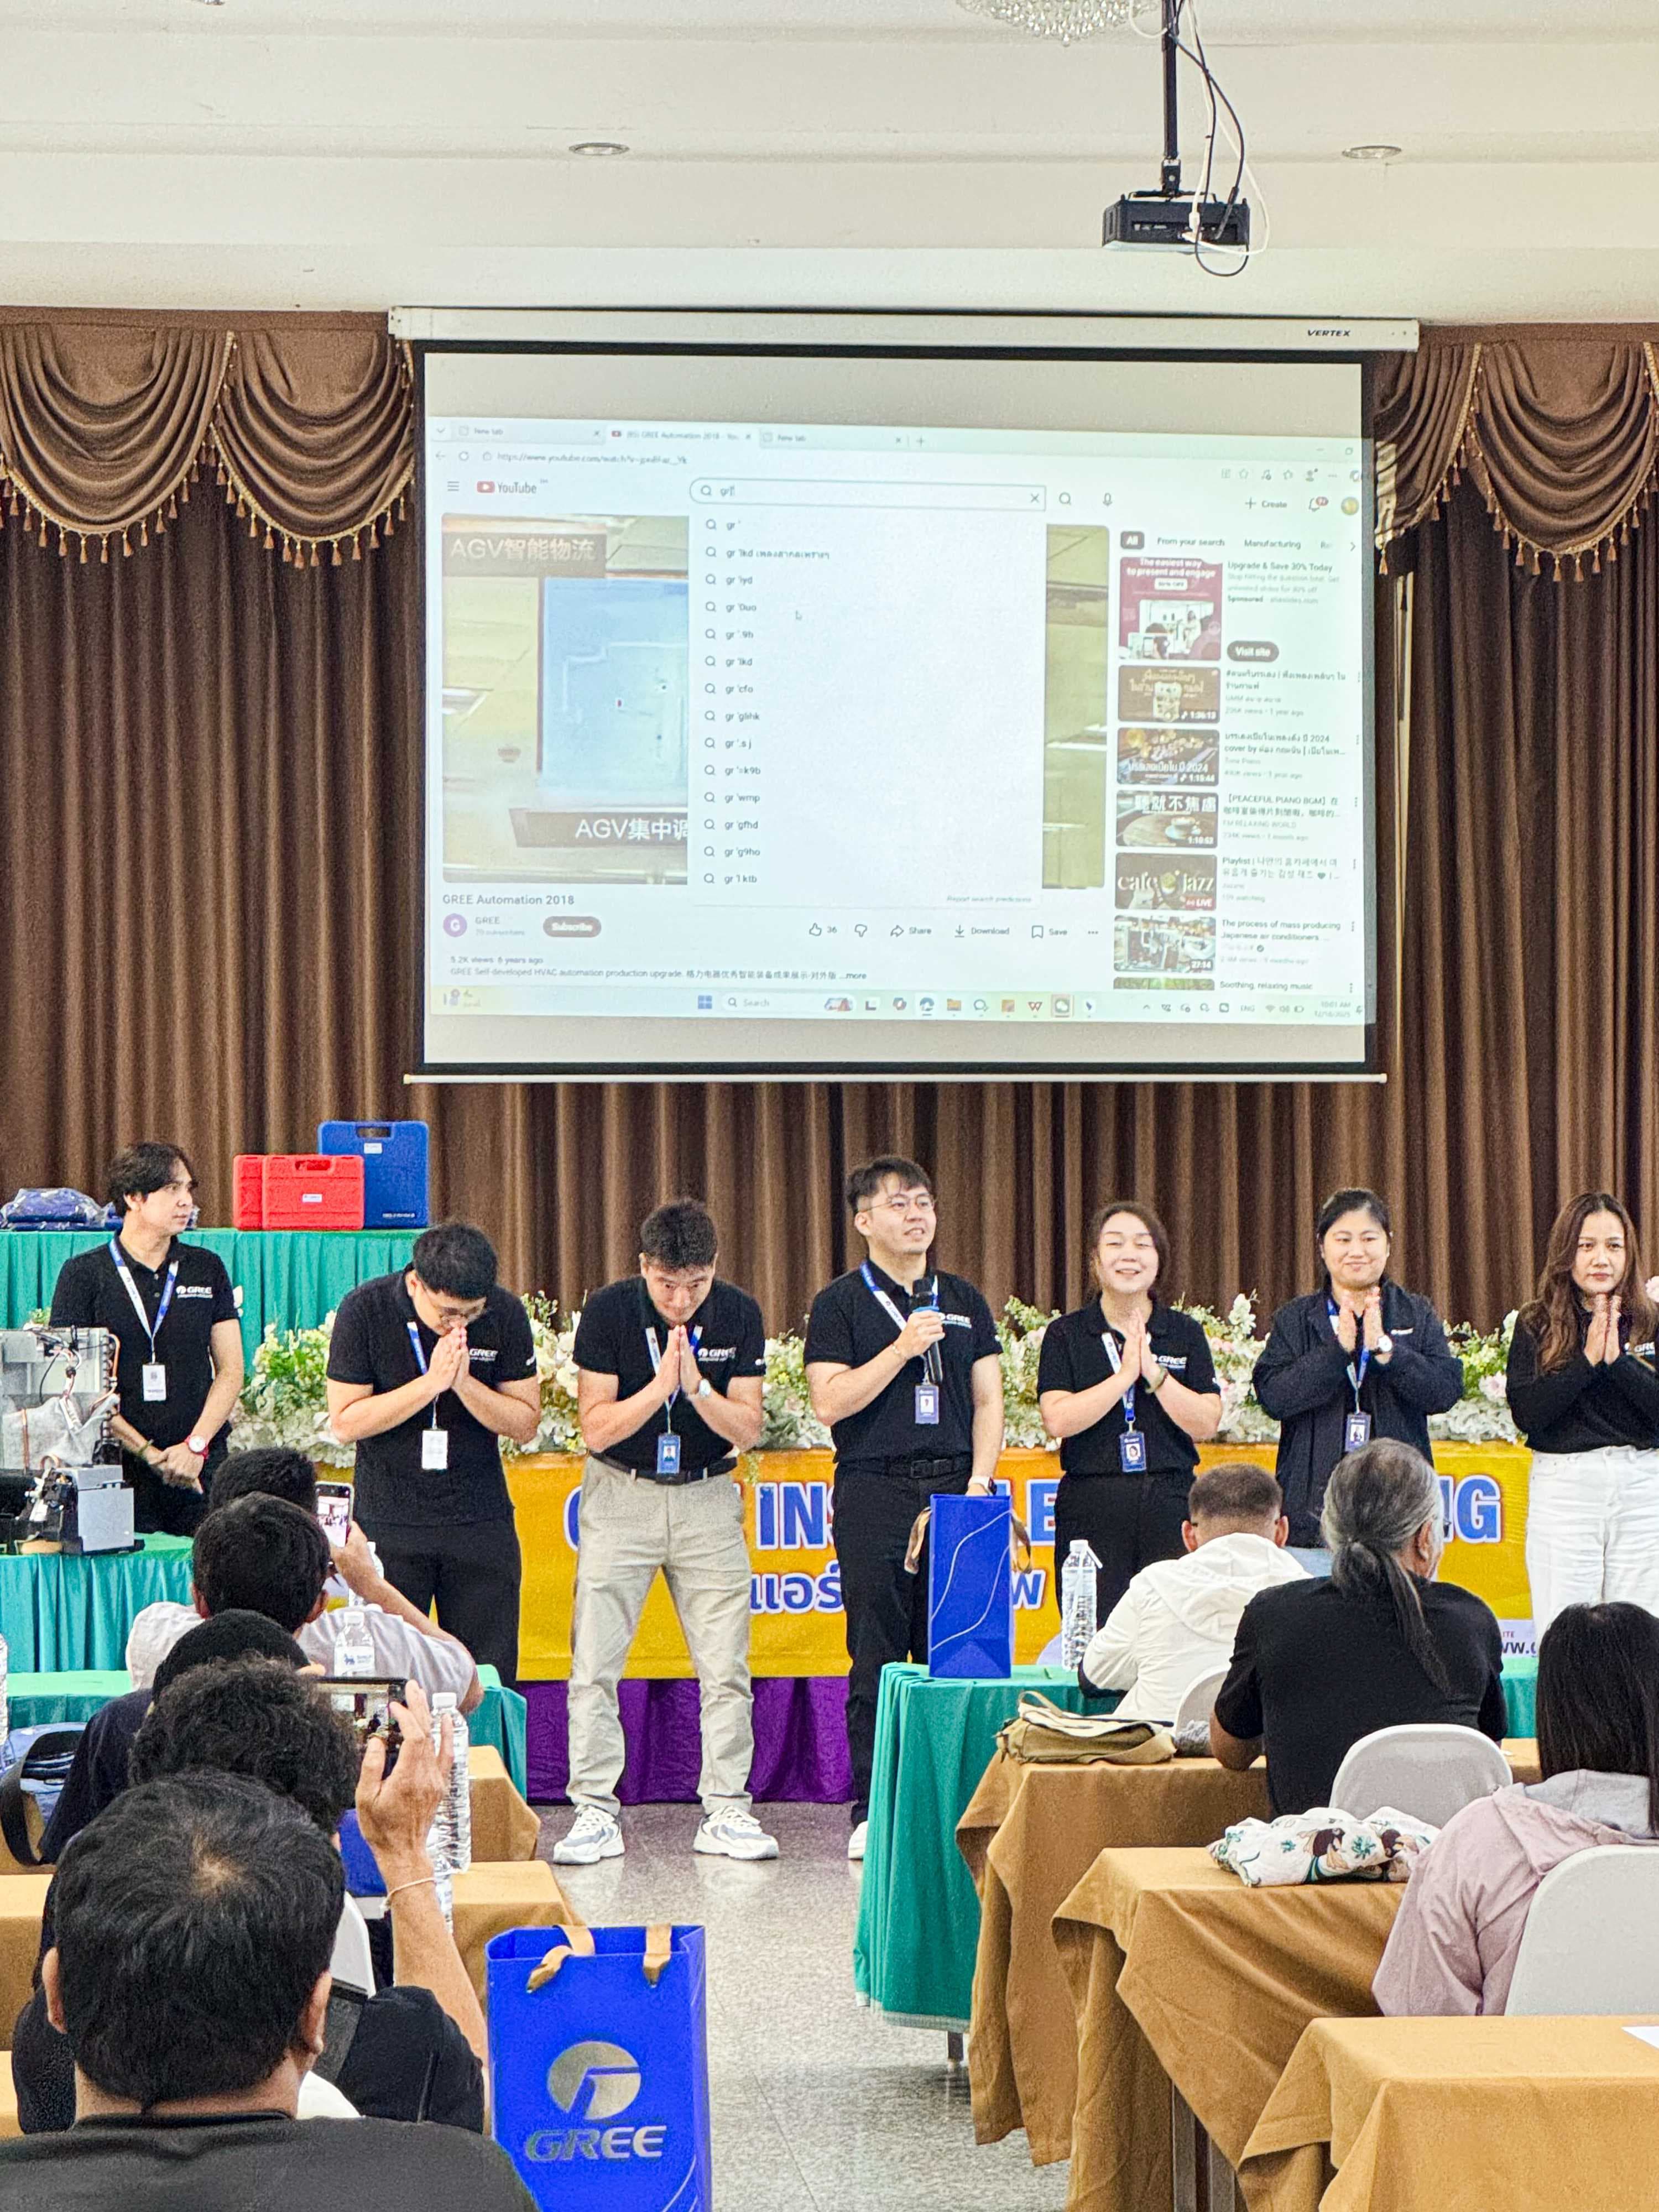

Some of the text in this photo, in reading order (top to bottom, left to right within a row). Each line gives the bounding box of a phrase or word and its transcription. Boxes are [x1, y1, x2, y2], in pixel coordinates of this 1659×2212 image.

[497, 481, 537, 494] YouTube
[1261, 499, 1287, 509] Create
[726, 522, 735, 530] gr
[1126, 535, 1139, 545] All
[1157, 537, 1225, 547] From your search
[1244, 539, 1302, 550] Manufacturing
[450, 538, 596, 562] AGV智能物流
[726, 550, 735, 559] gr
[1228, 561, 1260, 571] Upgrade
[1308, 563, 1333, 573] Today
[726, 577, 735, 585] gr
[1227, 595, 1264, 603] Sponsored
[726, 604, 735, 613] gr
[726, 632, 734, 640] gr
[1235, 646, 1271, 657] Visit site
[726, 659, 734, 667] gr
[726, 686, 734, 695] gr
[725, 713, 734, 722] gr
[1310, 734, 1330, 743] 2024
[725, 740, 734, 749] gr
[1248, 745, 1257, 754] by
[724, 768, 734, 776] gr
[724, 795, 734, 804] gr
[1275, 796, 1301, 805] PIANO
[724, 822, 733, 831] gr
[724, 849, 733, 857] gr
[1222, 856, 1251, 865] Playlist
[724, 876, 733, 885] gr
[442, 894, 575, 906] GREE Automation 2018
[1196, 899, 1213, 907] LIVE
[474, 916, 500, 925] GREE
[450, 920, 461, 931] G
[551, 922, 593, 932] Subscribe
[1237, 920, 1268, 928] process
[1302, 921, 1342, 931] producing
[909, 926, 932, 935] Share
[971, 927, 1010, 935] Download
[1220, 931, 1258, 940] Japanese
[504, 957, 526, 965] years
[450, 968, 472, 976] GREE
[559, 969, 604, 977] automation
[605, 969, 648, 979] production
[1257, 982, 1288, 992] relaxing
[743, 999, 770, 1008] Search
[755, 1482, 834, 1550] IN
[525, 2125, 667, 2162] GREE
